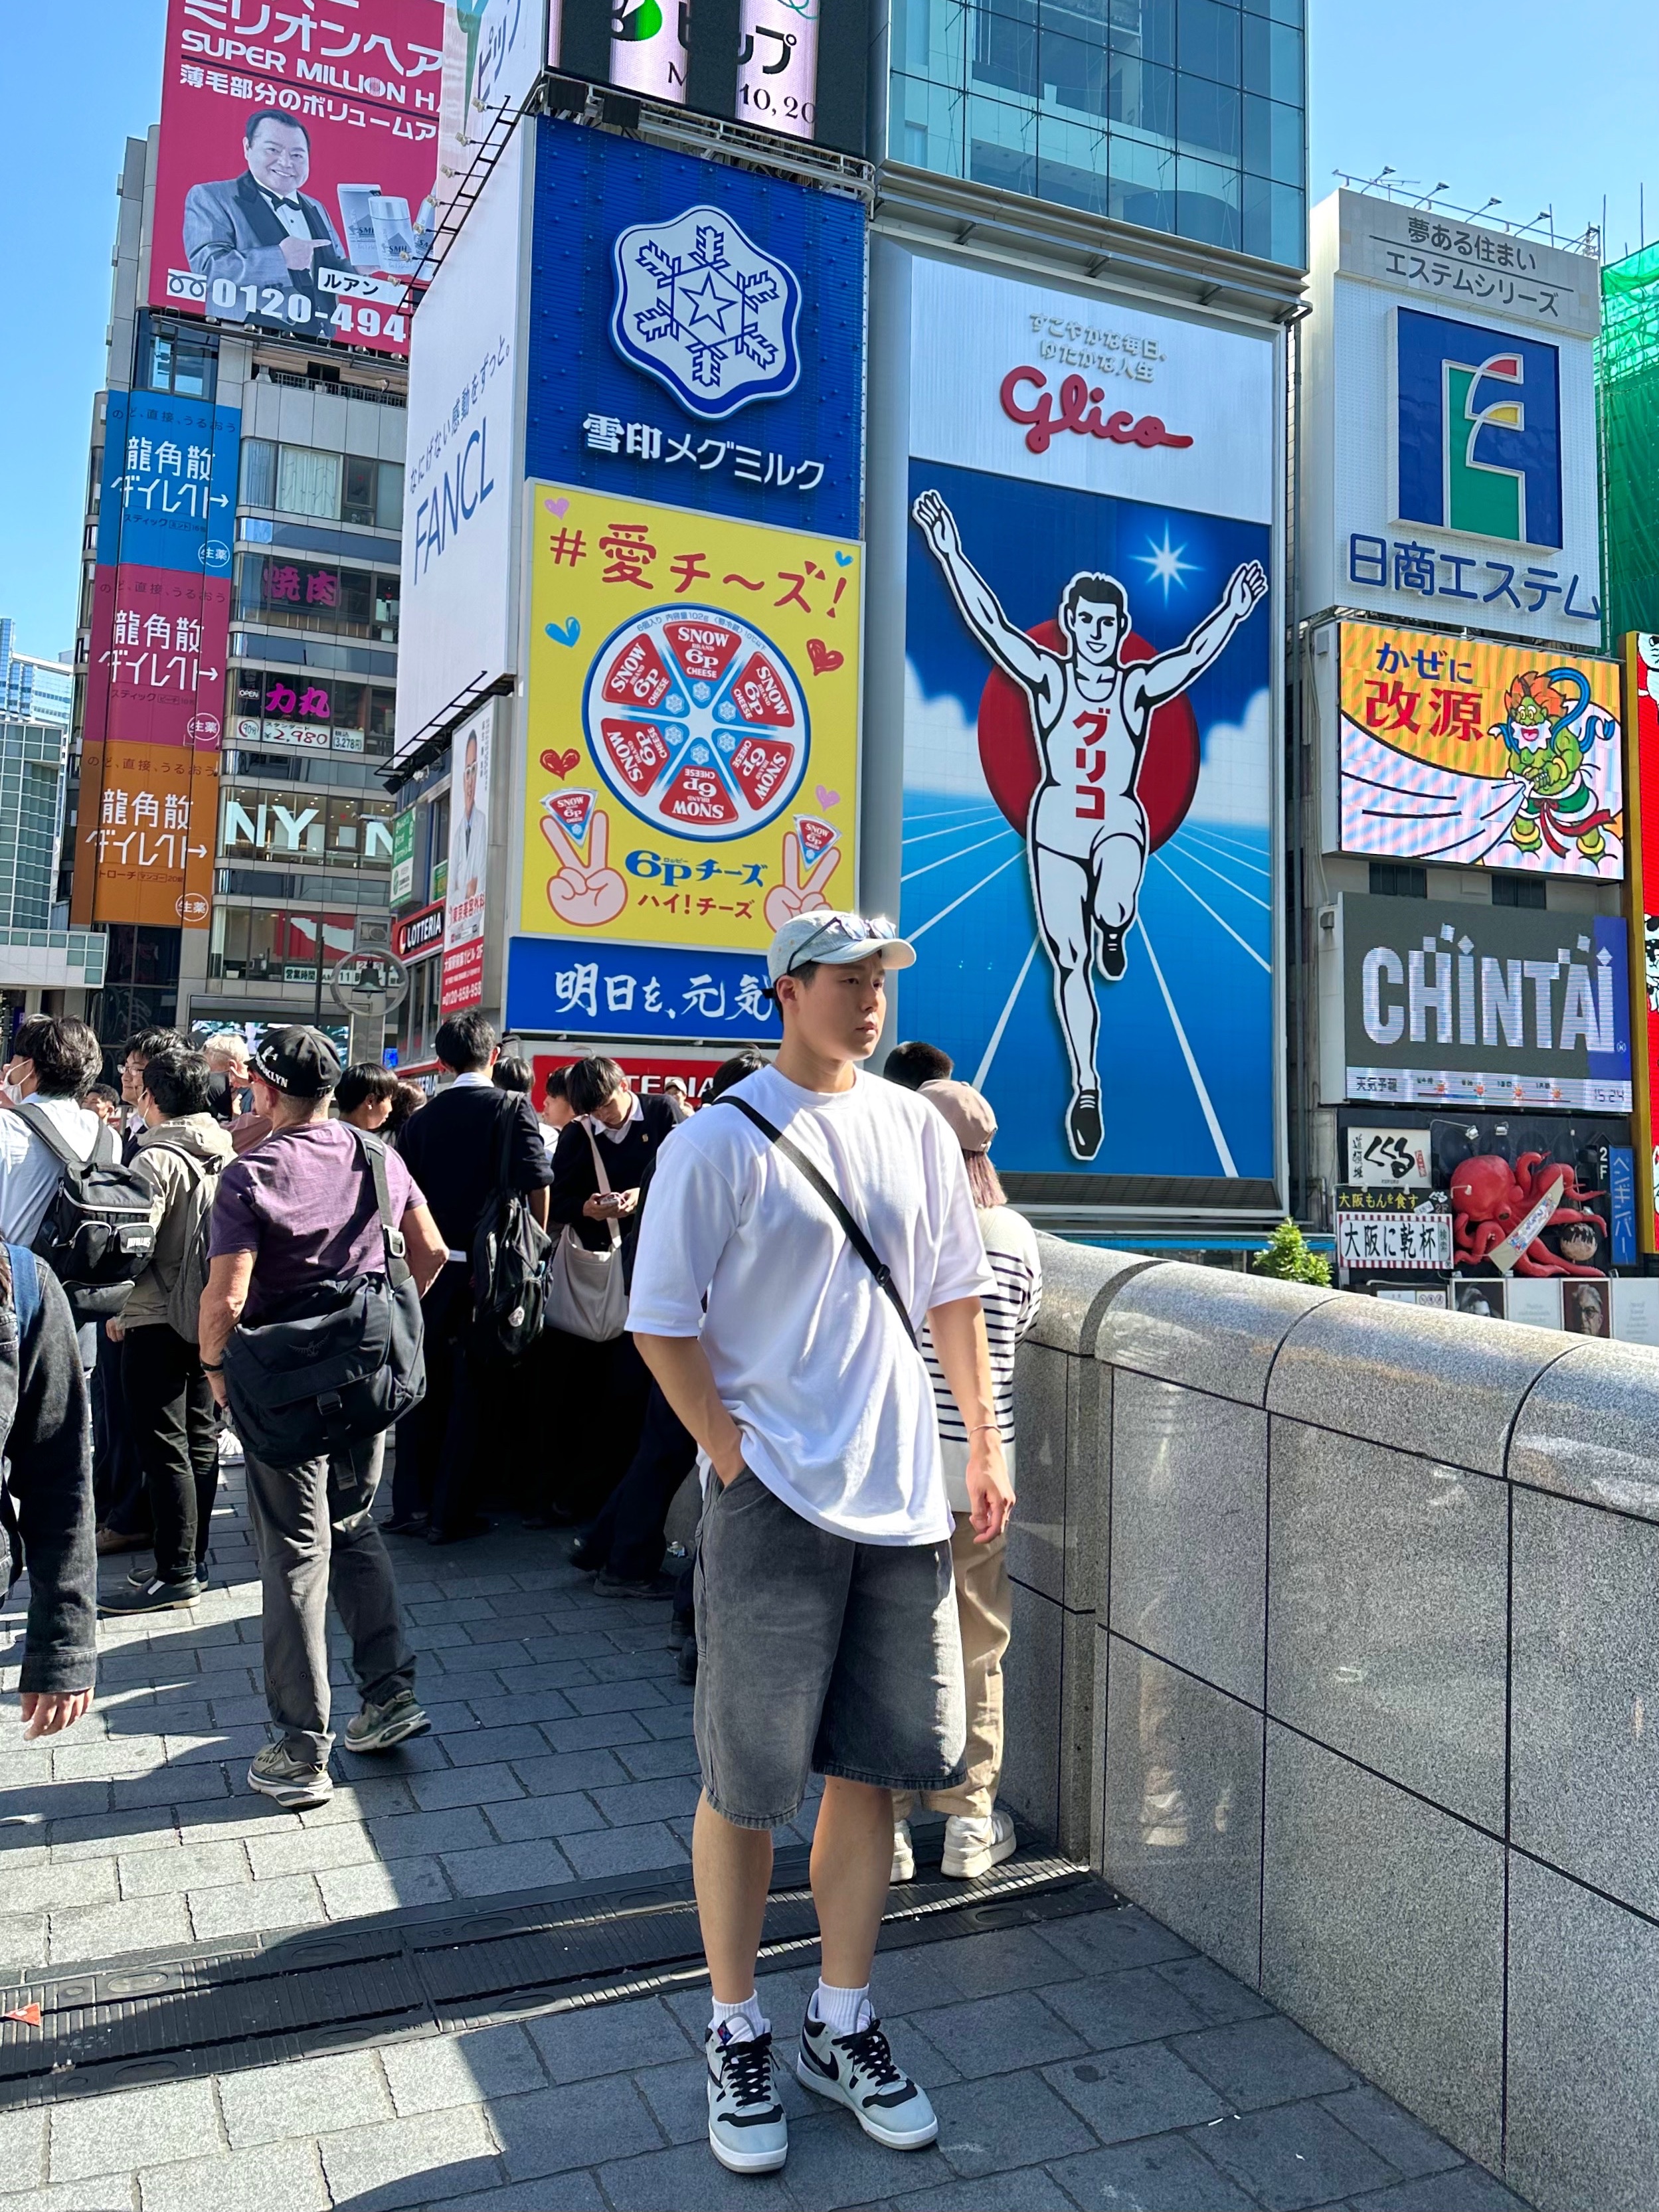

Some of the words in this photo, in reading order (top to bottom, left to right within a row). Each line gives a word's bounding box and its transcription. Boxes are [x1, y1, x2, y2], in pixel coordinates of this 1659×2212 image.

[181, 29, 286, 72] SUPER
[296, 58, 406, 104] MILLION
[414, 89, 442, 113] H
[180, 64, 437, 141] 薄毛部分のボリュームア
[1407, 216, 1536, 270] 夢ある住まい
[323, 273, 379, 296] ルアン
[1385, 250, 1559, 317] エステムシリーズ
[212, 278, 406, 340] 0120-494
[1040, 339, 1155, 383] ゆたかな人生
[1000, 365, 1194, 454] Glico
[127, 436, 216, 481] 龍角散
[582, 413, 824, 490] 雪印メグミルク
[110, 475, 229, 519] ダイレクト
[414, 416, 494, 587] FANCL
[200, 547, 228, 561] 生薬
[263, 565, 341, 608] 焼肉
[1350, 533, 1602, 621] 日商エステム
[115, 609, 205, 653] 龍角散
[678, 626, 730, 647] SNOW
[691, 643, 715, 651] BRAND
[98, 649, 218, 691] ダイレクト
[610, 642, 647, 693] SNOW
[630, 664, 646, 686] BRAND
[686, 666, 717, 679] CHEESE
[1376, 641, 1473, 685] かぜに
[239, 689, 258, 698] OPEN
[265, 683, 331, 719] 力丸
[648, 677, 670, 706] CHEESE
[733, 688, 754, 720] CHEESE
[756, 665, 790, 716] SNOW
[757, 683, 771, 707] BRAND
[189, 719, 217, 734] 生薬
[1363, 679, 1484, 742] 改源
[606, 730, 644, 782] SNOW
[628, 740, 642, 764] BRAND
[647, 726, 668, 759] CHEESE
[731, 739, 752, 769] CHEESE
[685, 768, 715, 780] CHEESE
[754, 751, 787, 802] SNOW
[1073, 707, 1111, 820] グリコ
[102, 788, 194, 830] 龍角散
[557, 796, 584, 808] SNOW
[672, 800, 725, 819] SNOW
[687, 795, 711, 804] BRAND
[85, 829, 208, 869] ダイレクト
[804, 823, 830, 837] SNOW
[98, 869, 137, 880] トローチ
[177, 900, 206, 914] 生薬
[407, 911, 442, 948] LOTTERIA
[286, 968, 316, 981] 営業時間
[555, 962, 773, 1021] 明日を、元気
[1362, 924, 1615, 1053] CHINTAI
[1338, 1192, 1419, 1210] 大阪もんを食す
[1435, 1204, 1450, 1214] 2F
[1344, 1222, 1437, 1260] 大阪に乾杯
